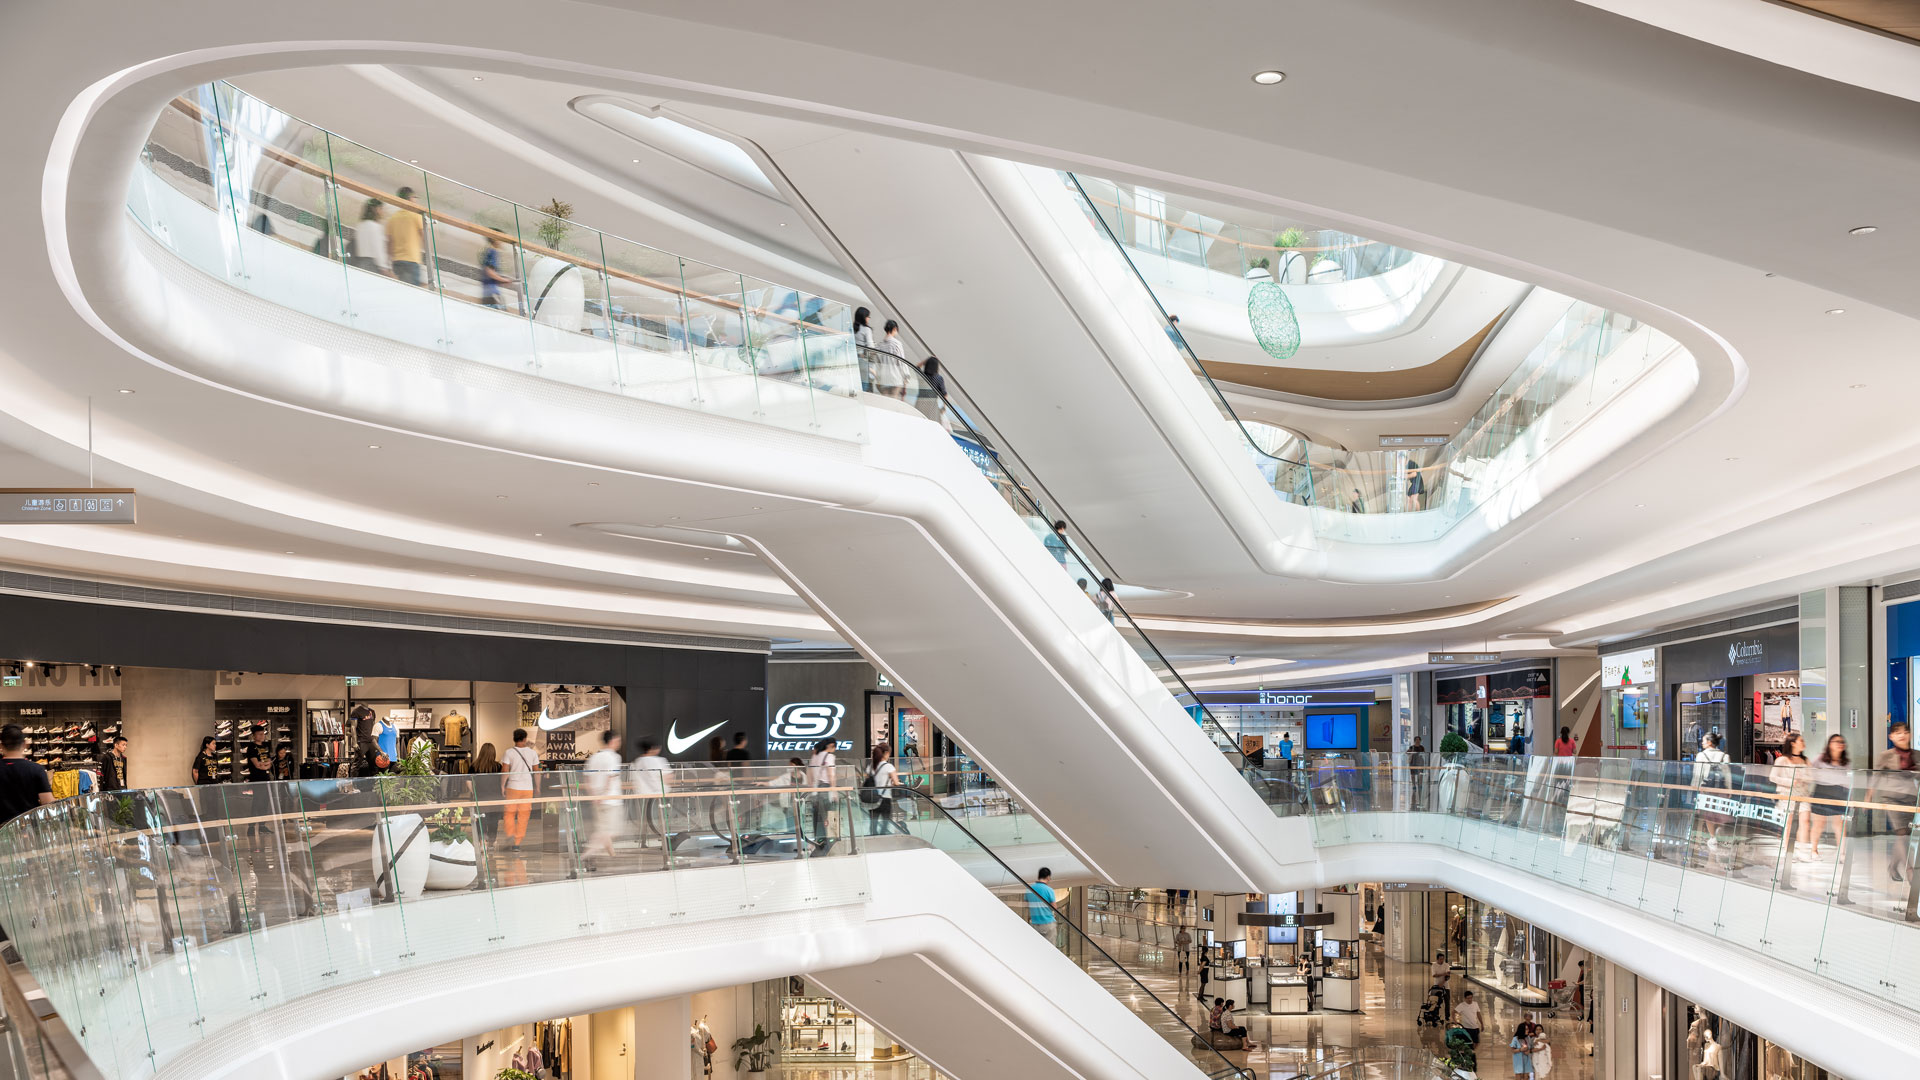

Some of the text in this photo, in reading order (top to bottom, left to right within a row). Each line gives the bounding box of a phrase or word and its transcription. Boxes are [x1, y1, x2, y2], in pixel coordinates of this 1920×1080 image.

[1736, 640, 1763, 658] Columbia
[1267, 692, 1313, 704] honor
[550, 733, 572, 741] RUN
[547, 742, 576, 751] AWAY
[768, 740, 853, 751] KECHS
[547, 752, 576, 760] FROM
